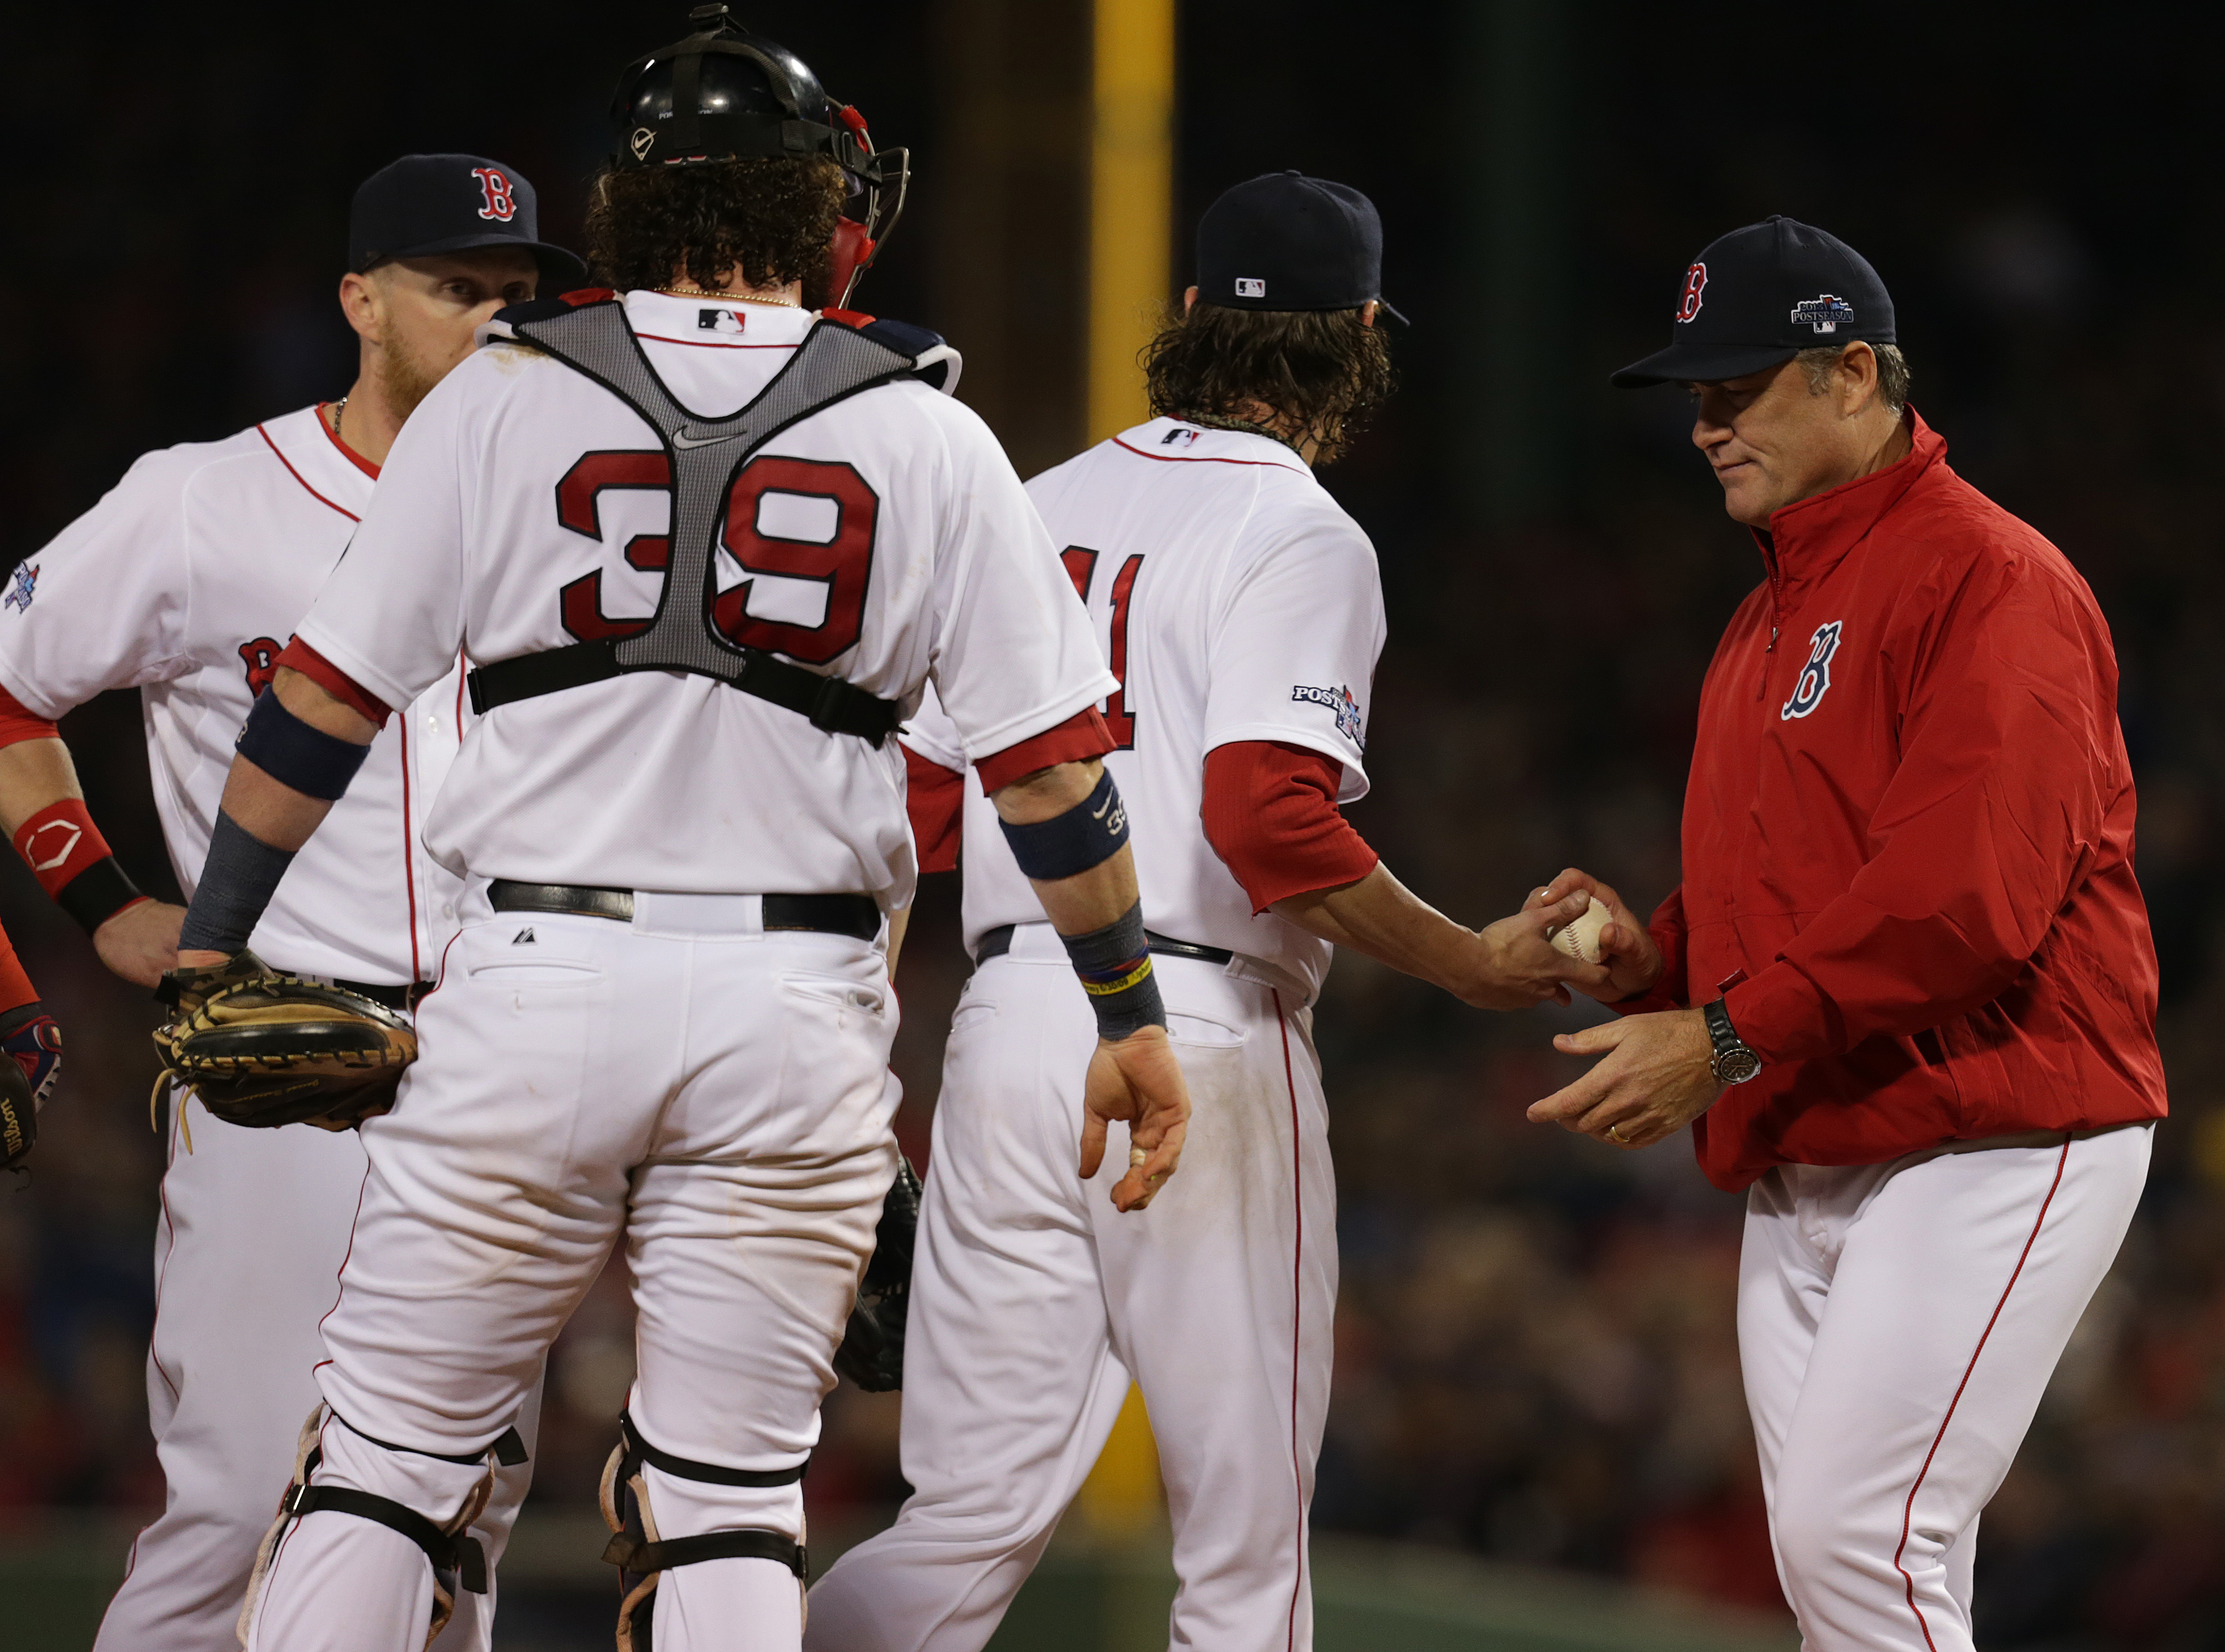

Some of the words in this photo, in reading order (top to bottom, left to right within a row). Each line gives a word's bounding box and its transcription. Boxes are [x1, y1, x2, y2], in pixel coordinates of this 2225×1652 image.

[471, 167, 517, 222] B
[1676, 262, 1708, 323] B
[1794, 310, 1852, 322] POSTSEASON
[555, 449, 880, 666] 39
[1780, 619, 1843, 721] B
[0, 1097, 23, 1156] Wilson
